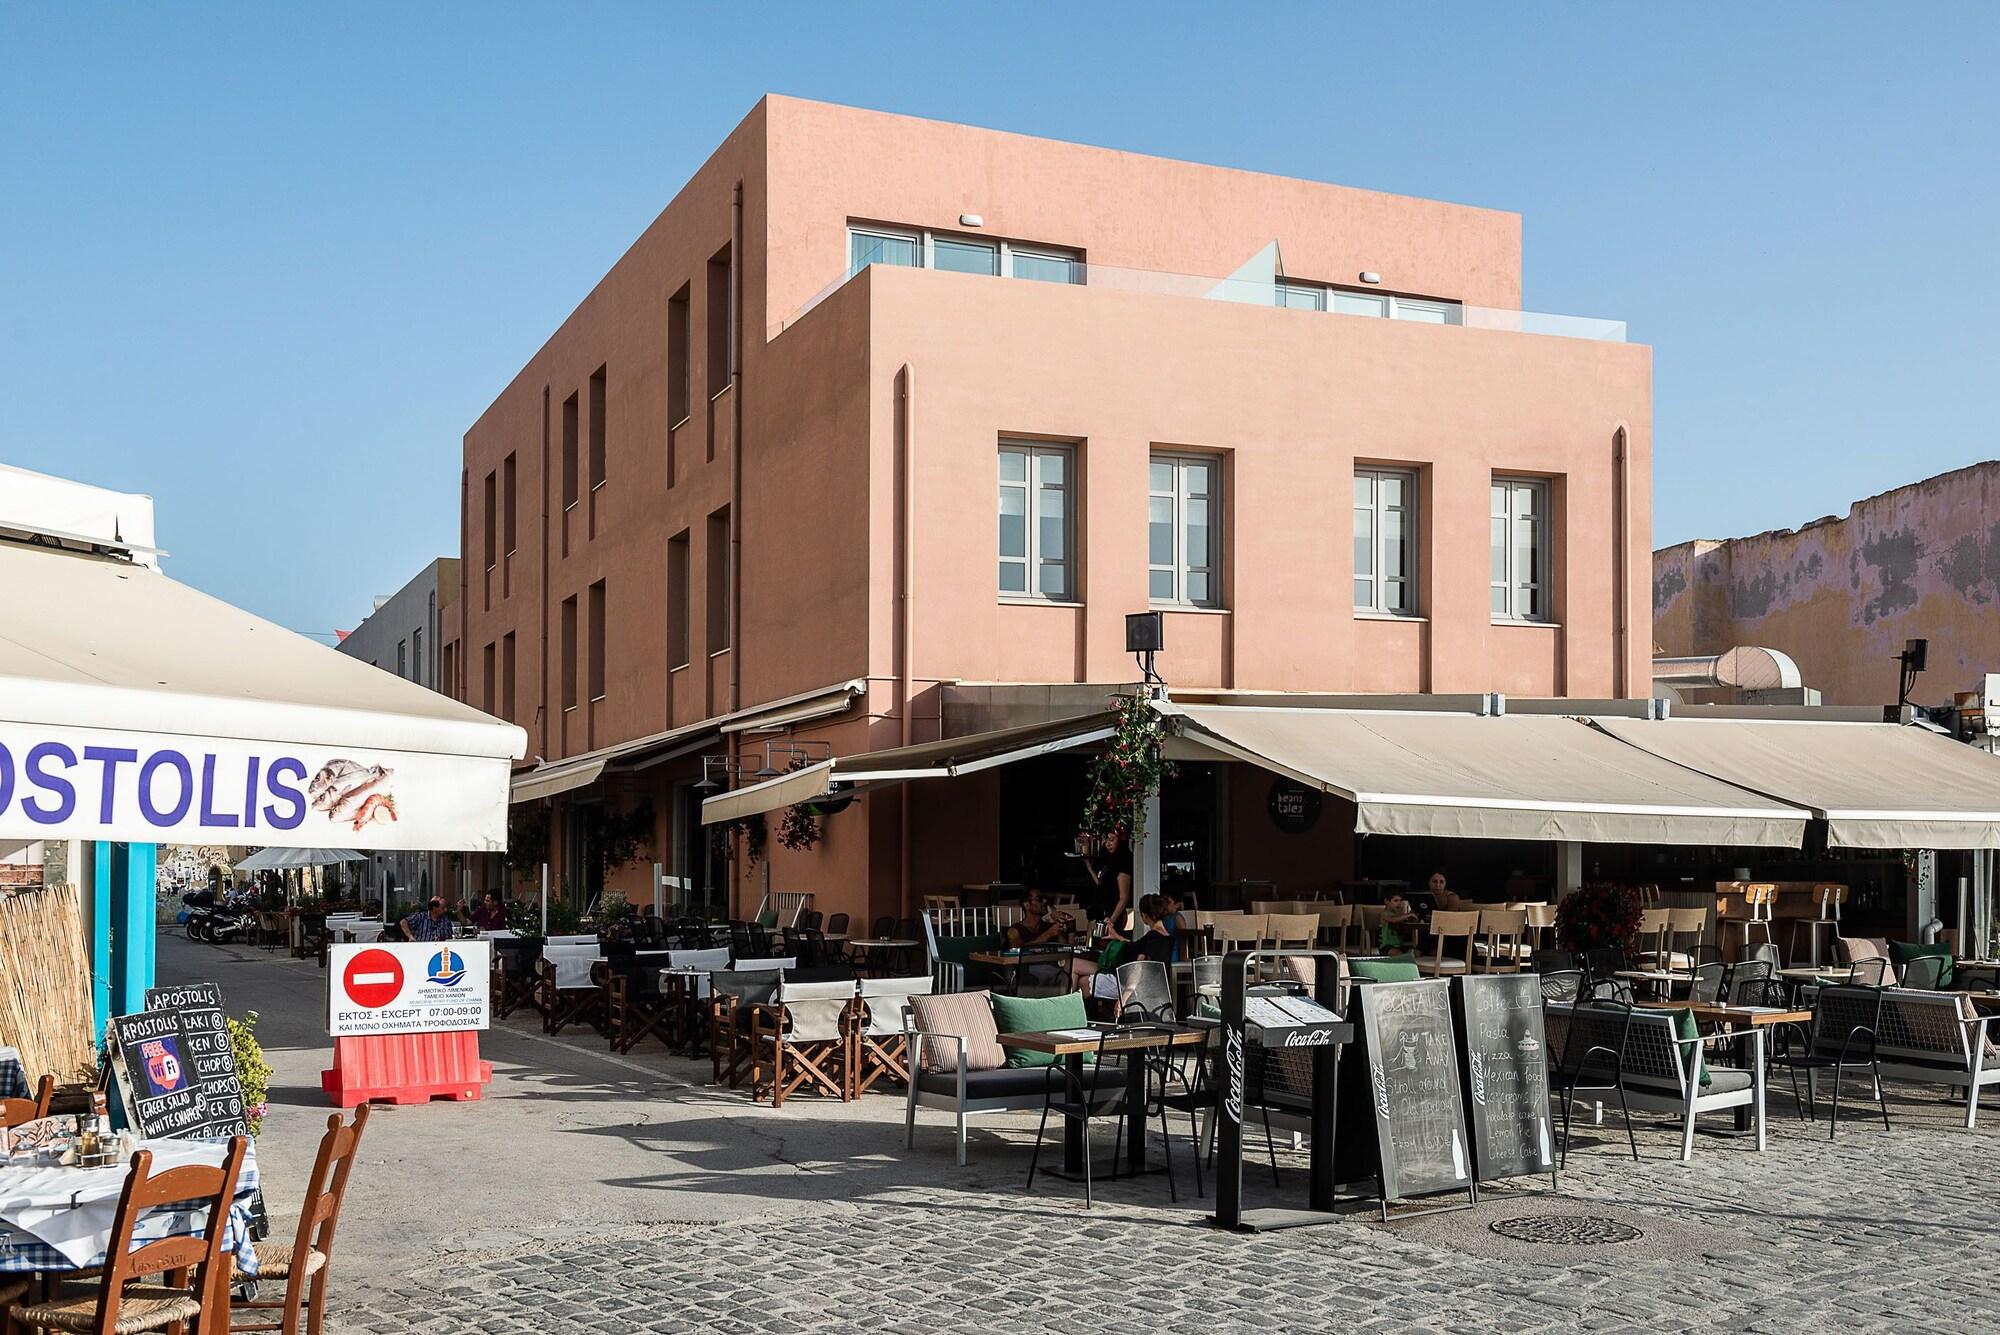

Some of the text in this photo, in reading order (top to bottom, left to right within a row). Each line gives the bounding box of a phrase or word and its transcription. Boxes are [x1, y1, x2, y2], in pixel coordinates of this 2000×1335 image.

[0, 741, 309, 831] STOLIS
[1278, 793, 1303, 803] beans
[1278, 803, 1303, 813] tales
[152, 990, 216, 1010] APOSTOLIS
[338, 1010, 372, 1020] ΕΚΤΟΣ
[381, 1009, 422, 1019] EXCEPT
[429, 1006, 481, 1017] 07:00-09:00
[122, 1015, 178, 1041] APOSTOLIS
[339, 1018, 480, 1031] ΚΑΙ ΜΟΝΟ ΟΧΗΜΑΤΑ ΤΡΟΦΟΔΟΣΙΑΣ
[1480, 1022, 1510, 1039] Pasta
[1421, 1031, 1447, 1046] TAKE
[142, 1040, 163, 1059] FREE
[1481, 1044, 1512, 1061] Pizza
[198, 1059, 220, 1073] CHOP
[1425, 1050, 1449, 1067] AWAY
[1484, 1066, 1543, 1086] Mexican food
[1385, 1075, 1416, 1096] Stroll
[143, 1100, 167, 1118] GREEK
[167, 1092, 190, 1109] SALAD
[1489, 1124, 1514, 1138] Lemon
[1488, 1143, 1538, 1160] Cheese Cake
